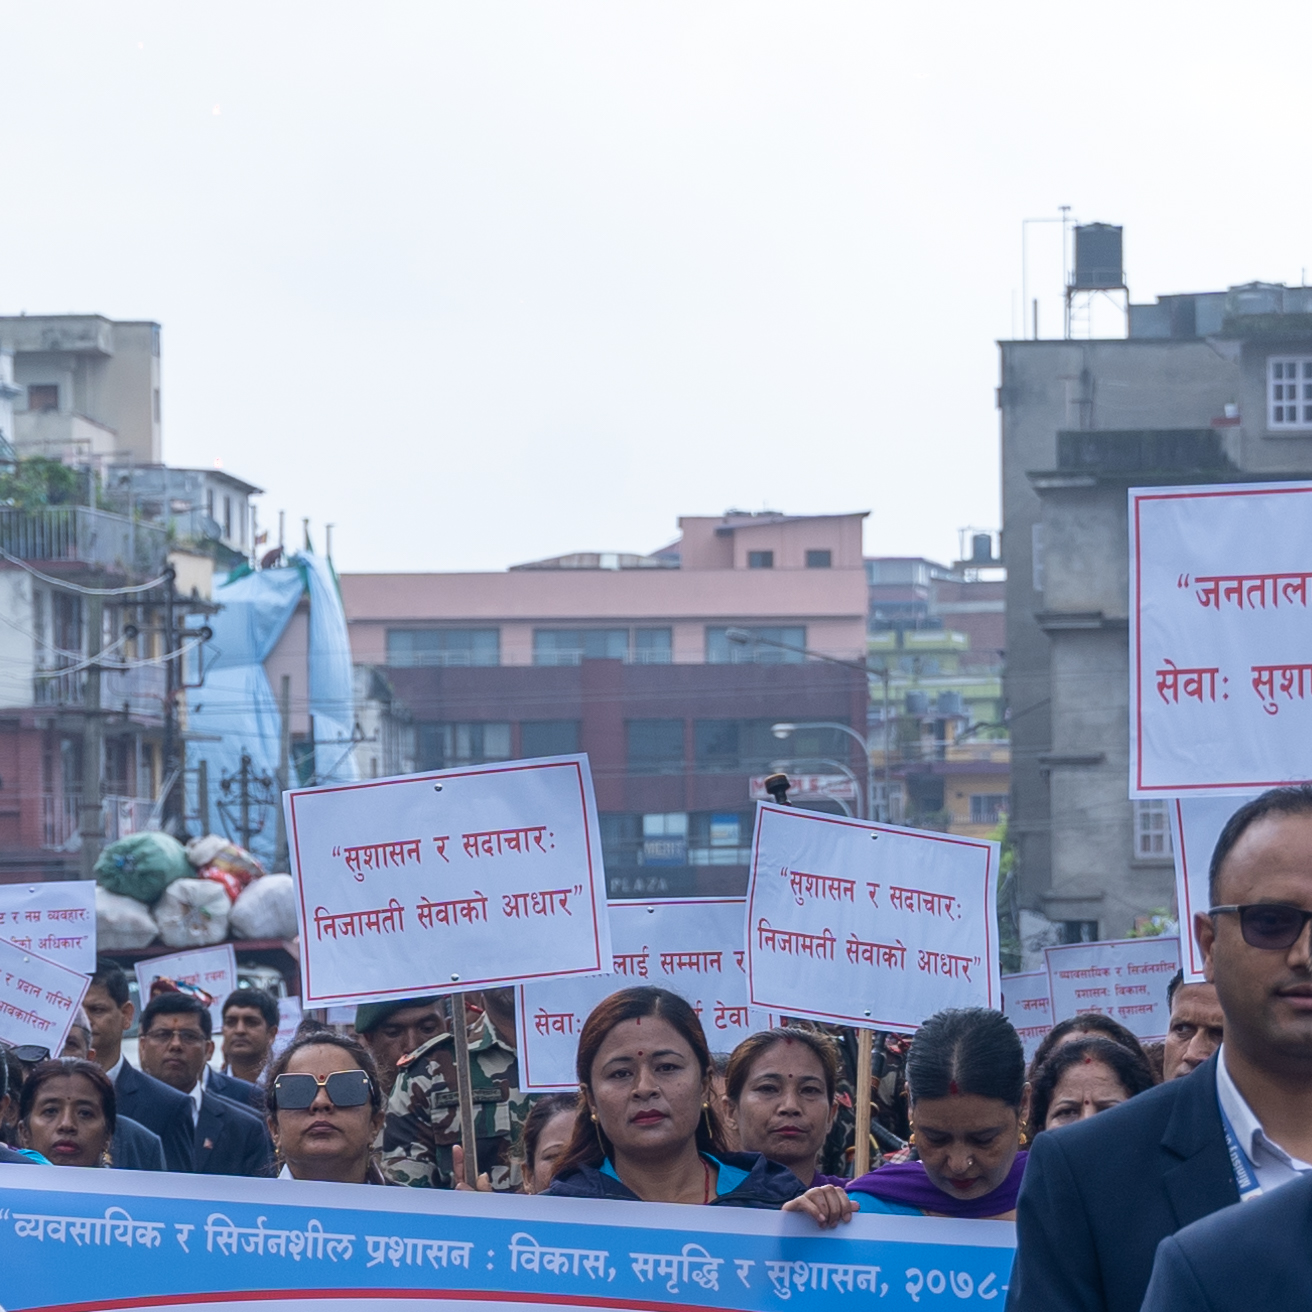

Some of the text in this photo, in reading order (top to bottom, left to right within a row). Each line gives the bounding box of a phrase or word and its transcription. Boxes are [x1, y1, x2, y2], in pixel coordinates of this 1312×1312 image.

[333, 838, 421, 882] “सुशासन
[433, 836, 450, 863] र
[781, 867, 856, 906] “सुशासन
[866, 882, 880, 909] र
[11, 911, 19, 924] र
[314, 884, 582, 941] निजामती सेवाको आधार”
[660, 951, 723, 975] सम्मान
[733, 950, 746, 974] र
[758, 918, 981, 984] निजामती सेवाको आधार”
[1115, 967, 1122, 977] र
[6, 973, 14, 986] र
[16, 979, 42, 998] प्रदान
[46, 990, 72, 1011] गरिने
[175, 1224, 195, 1254] र
[204, 1213, 355, 1264] सिर्जनशील
[366, 1235, 474, 1270] प्रशासन
[508, 1232, 617, 1282] विकास,
[629, 1243, 724, 1294] समृद्धि
[735, 1259, 756, 1289] र
[766, 1259, 888, 1300] सुशासन,
